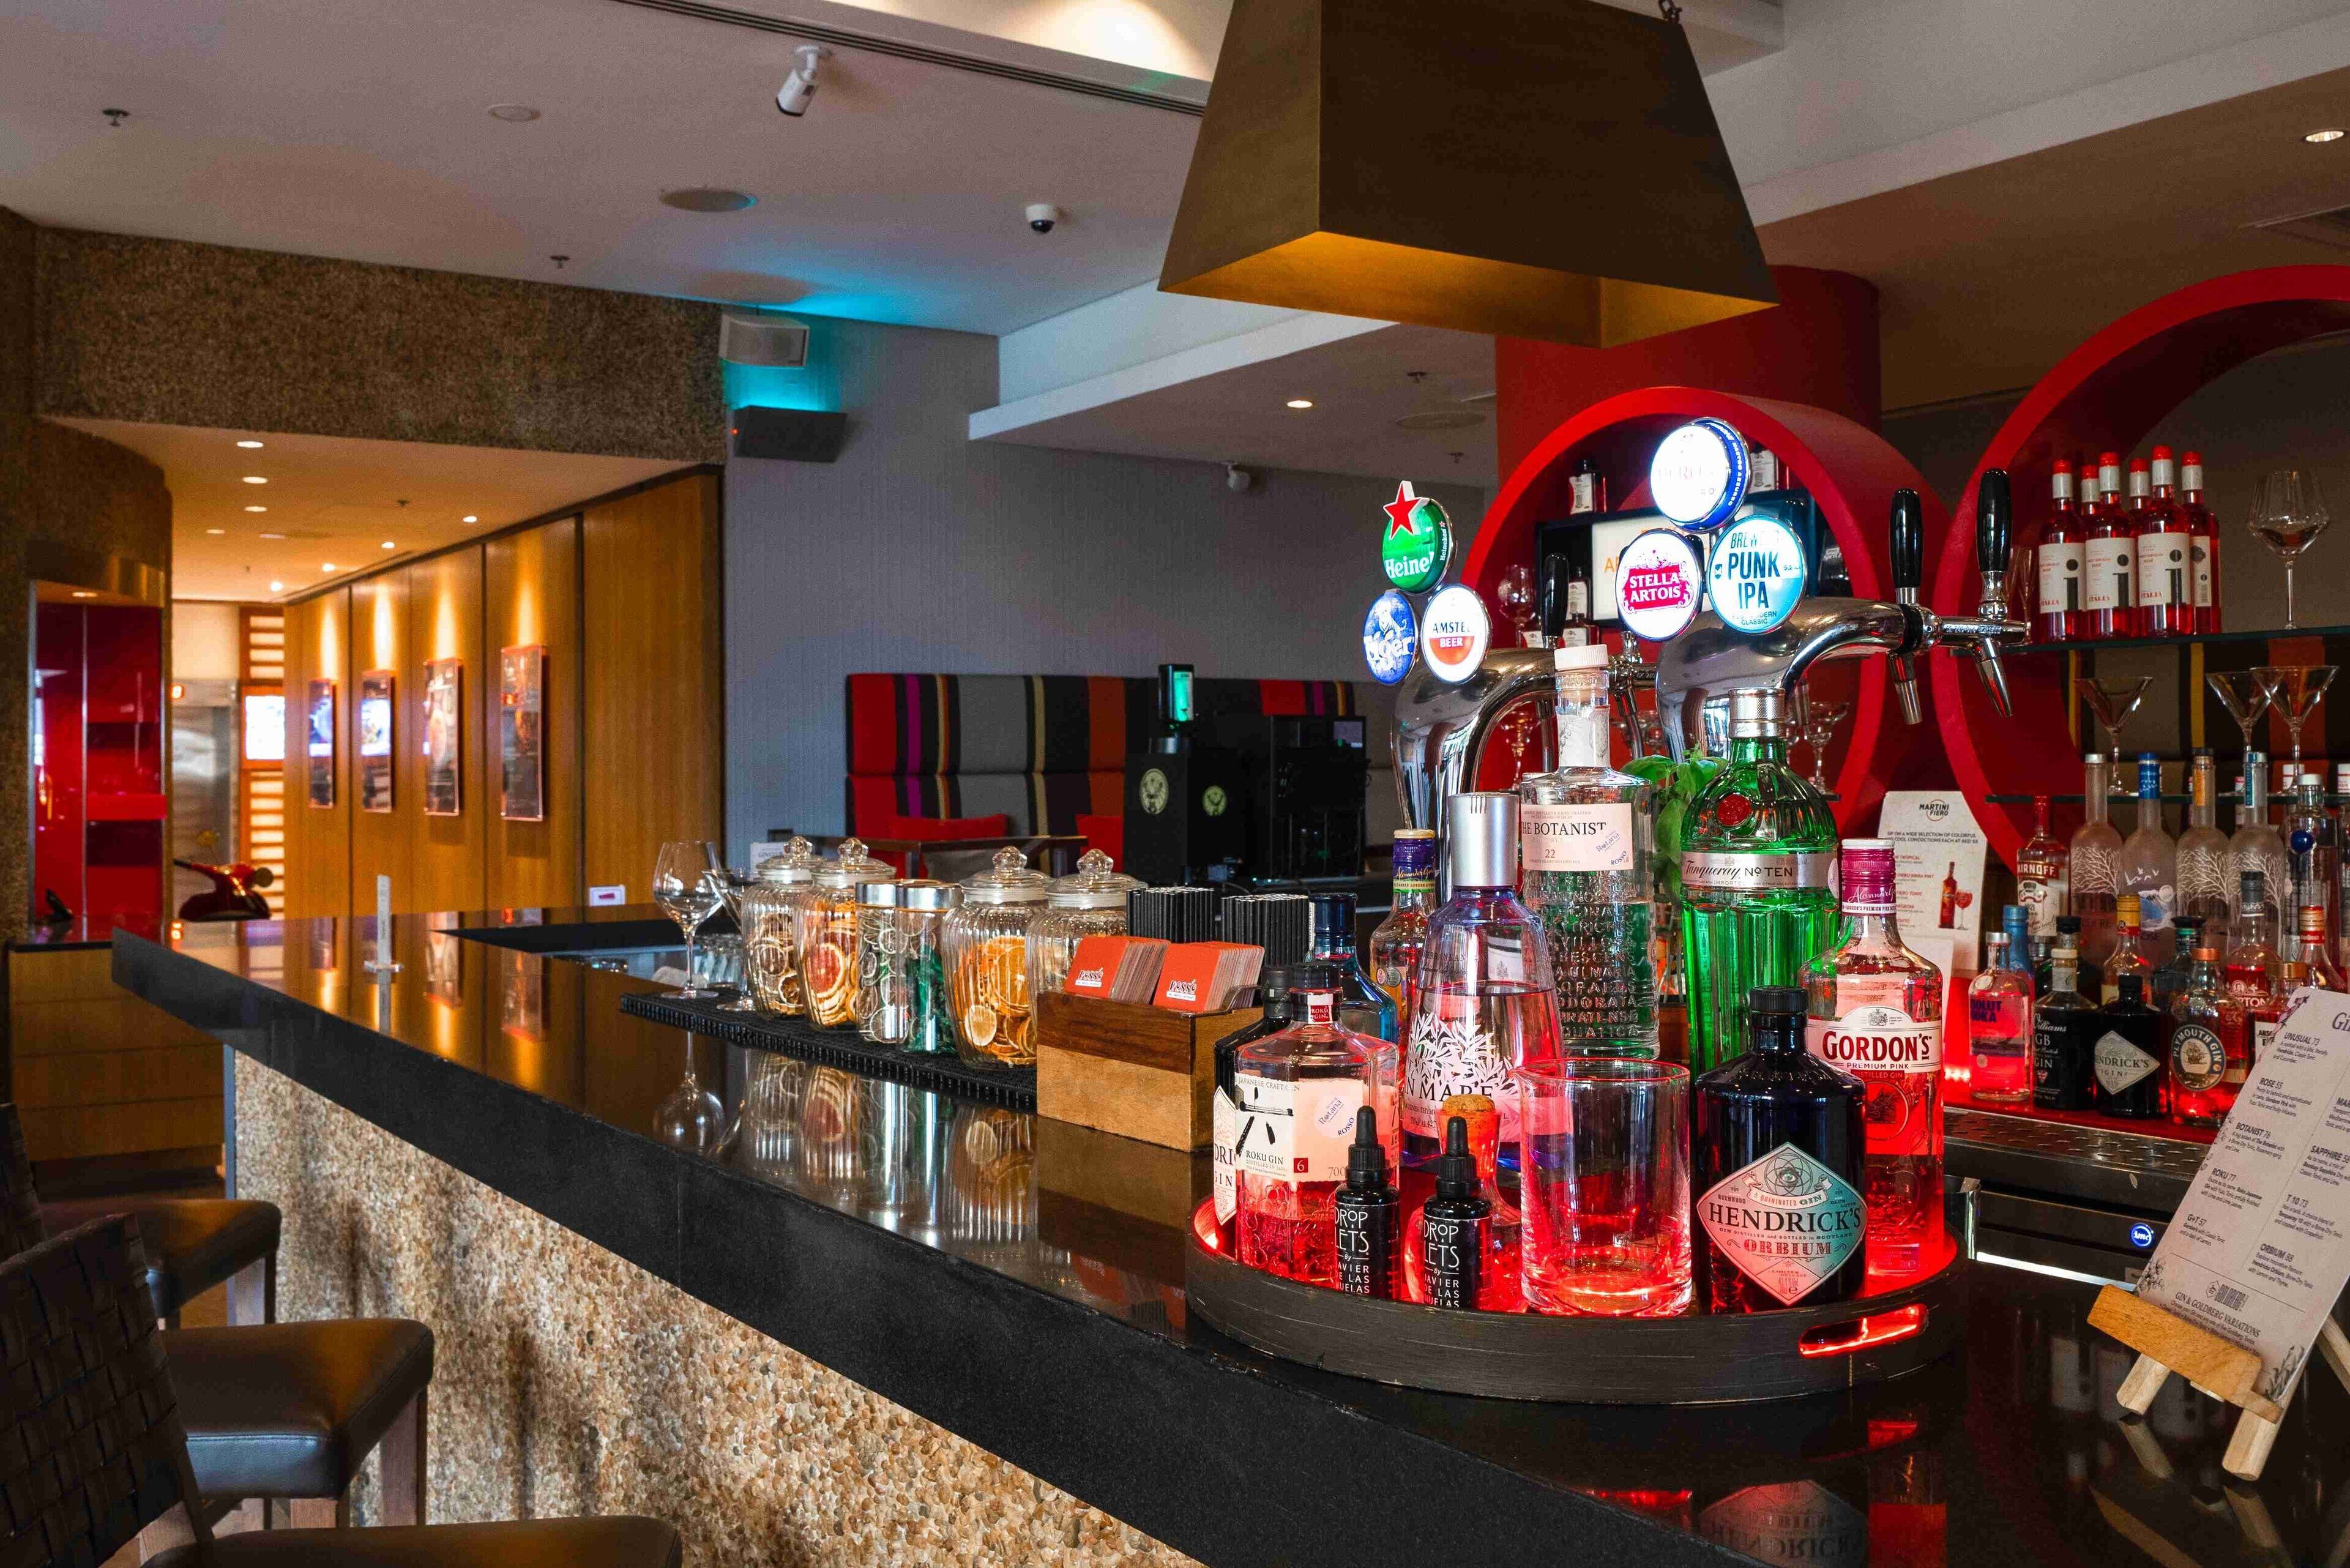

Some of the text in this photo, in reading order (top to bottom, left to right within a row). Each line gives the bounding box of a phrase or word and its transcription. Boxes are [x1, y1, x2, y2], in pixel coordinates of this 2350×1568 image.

[1728, 551, 1780, 580] PUNK
[1629, 572, 1680, 589] STELLA
[1630, 586, 1681, 603] ARTOIS
[1739, 581, 1769, 609] IPA
[1433, 622, 1469, 633] AMSTE
[1439, 637, 1464, 648] BEER
[1534, 822, 1606, 835] BOTANIST
[1545, 849, 1555, 858] 22
[1611, 851, 1627, 865] ROSSO
[1685, 861, 1741, 880] Tanqueray
[1764, 867, 1792, 876] TEN
[2332, 1012, 2350, 1032] Gi
[2035, 1033, 2051, 1046] GB
[2285, 1032, 2311, 1044] UNUSUAL
[1822, 1031, 1930, 1061] GORDON'S
[2173, 1029, 2223, 1062] PLYMOUTH GIN
[2034, 1057, 2053, 1069] GIN
[2095, 1055, 2149, 1069] ENDRICK'S
[1238, 1077, 1284, 1091] JAPANESE CRAFT
[2259, 1078, 2276, 1087] ROSE
[1338, 1117, 1354, 1136] ROSSO
[2236, 1122, 2264, 1136] BOTANIST
[1246, 1150, 1283, 1164] ROKU GIN
[2311, 1145, 2343, 1160] SAPPHIRE
[1297, 1162, 1304, 1171] 6
[1214, 1170, 1233, 1187] GIN
[2212, 1168, 2237, 1181] ROKU 77
[1718, 1194, 1746, 1204] WORMWOOD
[1761, 1195, 1797, 1206] QUININATED
[1799, 1195, 1821, 1206] GIN
[1335, 1207, 1368, 1228] DROP
[1709, 1202, 1861, 1233] HENDRICK'S
[1424, 1220, 1458, 1243] DROP
[1335, 1226, 1369, 1253] LETS
[1744, 1238, 1832, 1255] ORBIUM
[1424, 1241, 1460, 1267] LETS
[2260, 1243, 2286, 1258] ORBIUM
[1349, 1274, 1370, 1283] LAS
[1438, 1288, 1460, 1298] LAS
[2175, 1291, 2187, 1303] GIN
[2191, 1299, 2224, 1320] GOLDBERG
[2223, 1312, 2261, 1337] VARIATIONS
